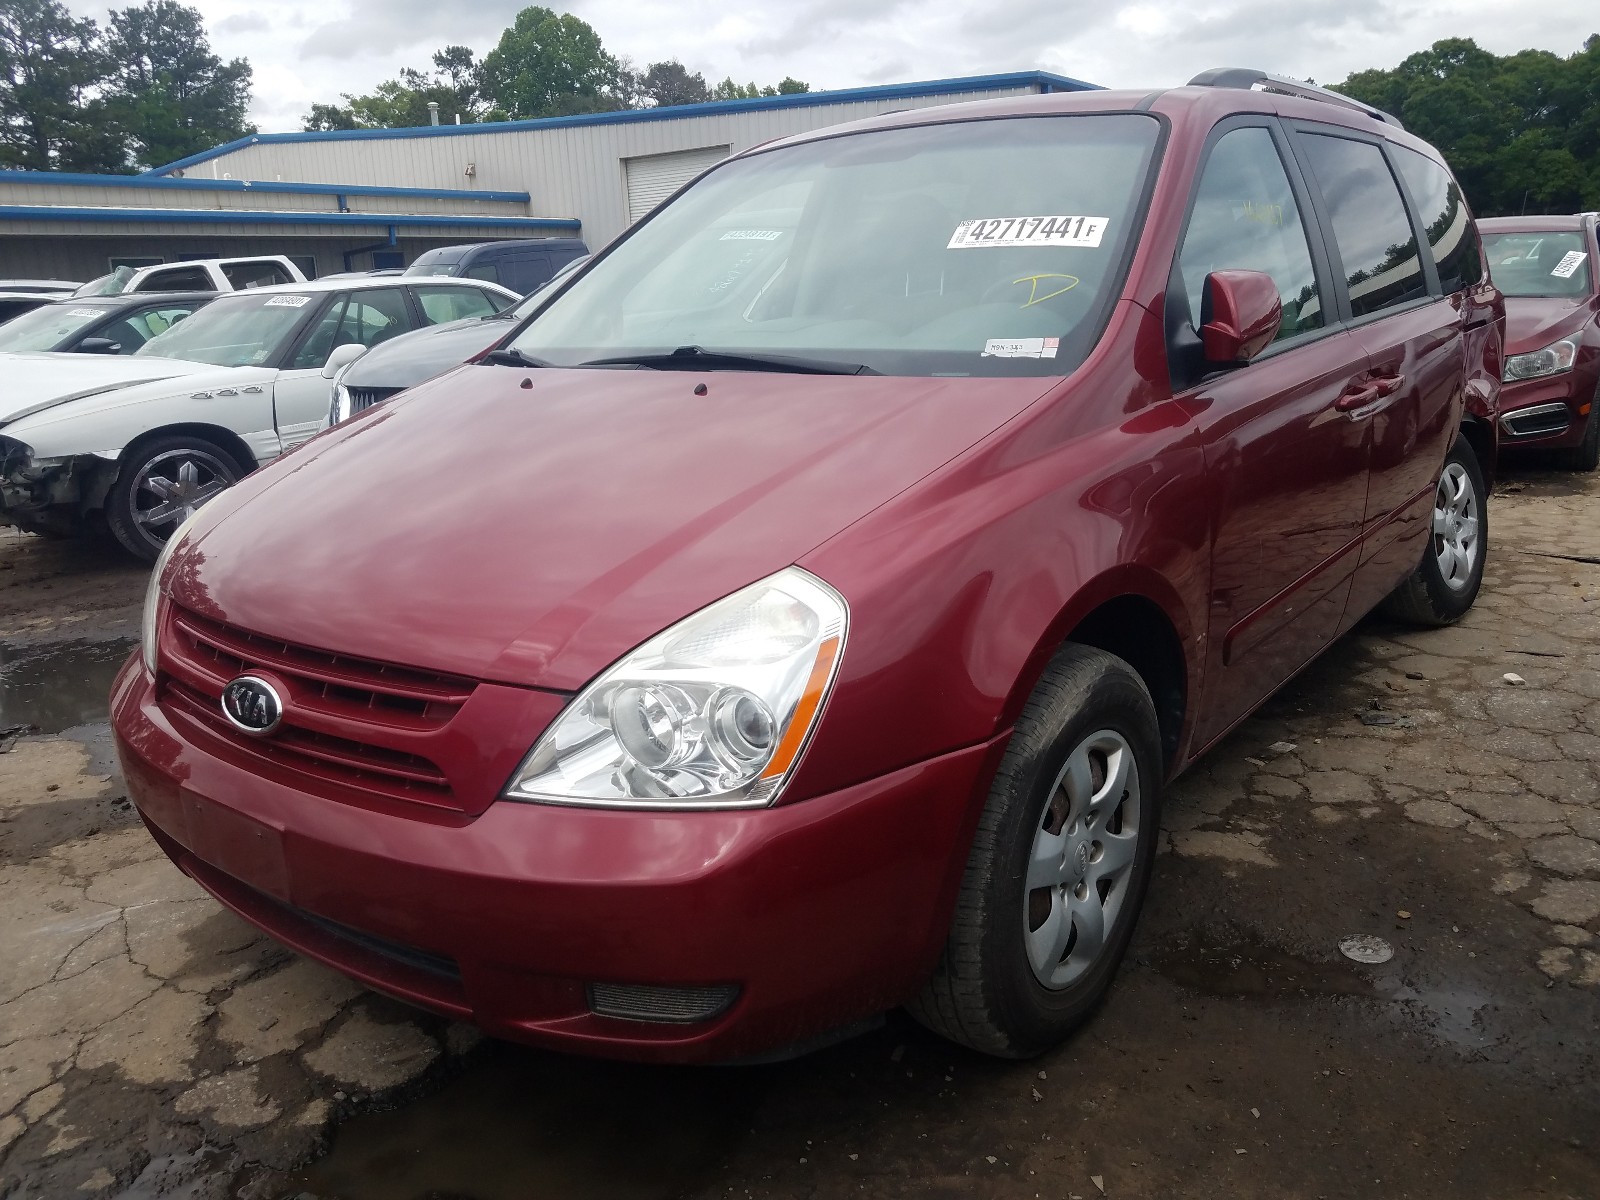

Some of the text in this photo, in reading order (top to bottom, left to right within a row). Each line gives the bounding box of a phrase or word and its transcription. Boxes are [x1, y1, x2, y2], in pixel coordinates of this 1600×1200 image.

[969, 217, 1086, 241] 42717441
[1086, 224, 1097, 237] F
[231, 684, 268, 725] KIA
